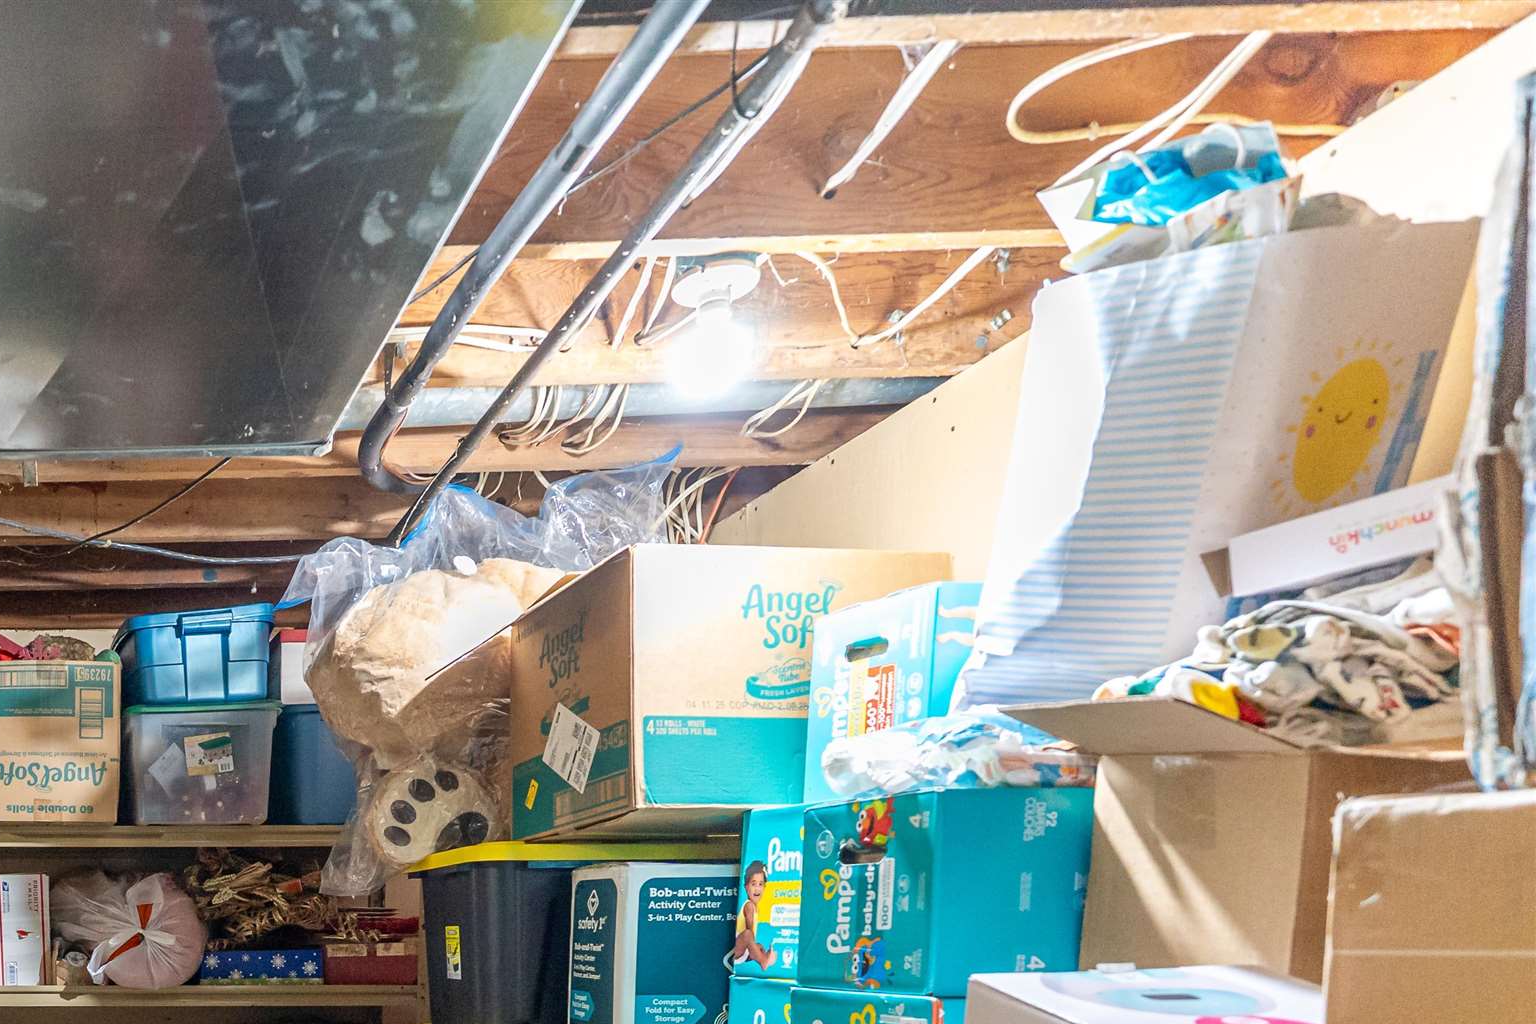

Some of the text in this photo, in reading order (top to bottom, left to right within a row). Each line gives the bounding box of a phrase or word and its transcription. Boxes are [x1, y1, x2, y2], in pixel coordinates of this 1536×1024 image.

[1328, 511, 1434, 554] munchkin
[741, 584, 835, 620] Angel
[763, 615, 814, 648] Sof
[539, 610, 586, 669] Angel
[549, 645, 580, 688] Soft
[646, 720, 656, 735] 4
[41, 760, 107, 790] Angel
[6, 805, 94, 814] 60 Double Rolls
[1046, 811, 1058, 827] 92
[649, 887, 738, 898] Bob-and-Twist
[648, 900, 721, 910] Activity Center
[826, 864, 856, 954] Pampe
[577, 917, 598, 933] safety
[675, 914, 692, 922] Play
[694, 914, 724, 922] Center,
[1026, 955, 1046, 970] 4
[653, 998, 688, 1006] Compact
[677, 1007, 696, 1015] Easy
[655, 1015, 685, 1023] Storage
